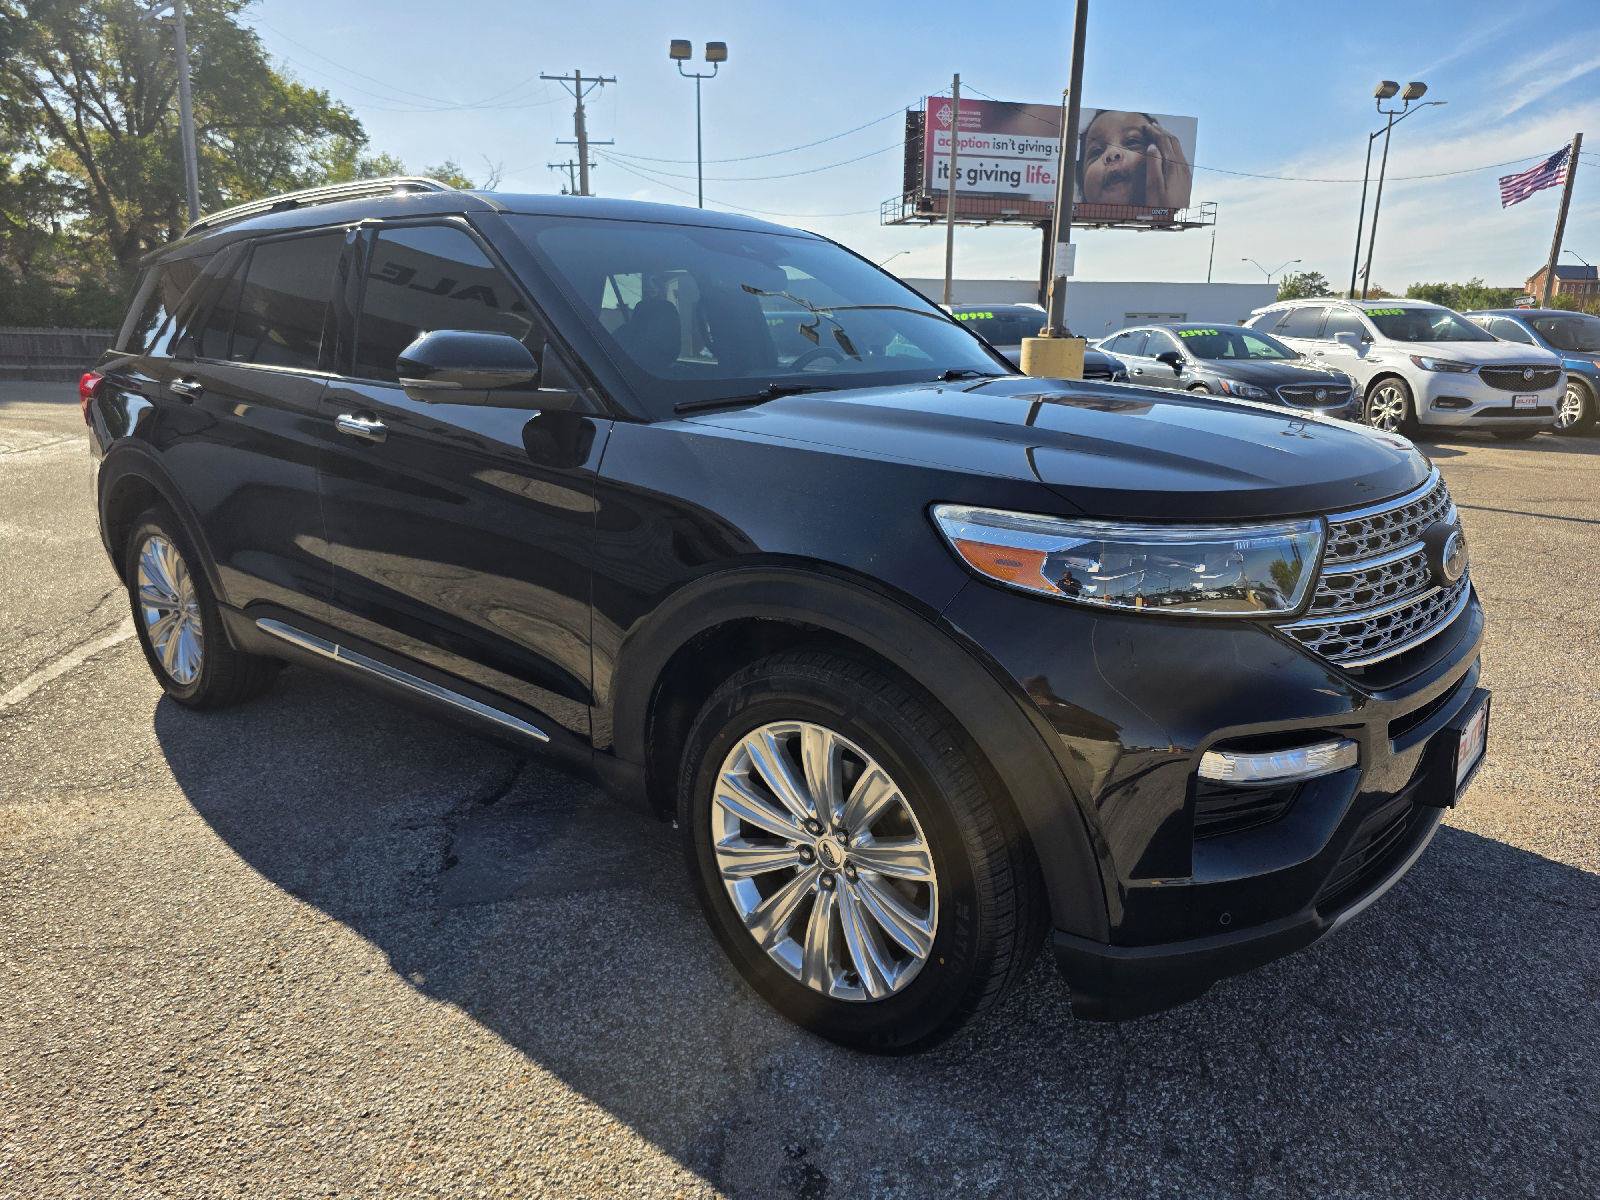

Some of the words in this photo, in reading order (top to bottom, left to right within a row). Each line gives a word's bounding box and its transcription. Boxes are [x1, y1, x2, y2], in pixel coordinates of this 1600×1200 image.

[992, 138, 1015, 151] isn't
[1017, 140, 1052, 156] giving
[938, 161, 962, 179] its
[967, 162, 1021, 188] giving
[1026, 164, 1056, 184] life.
